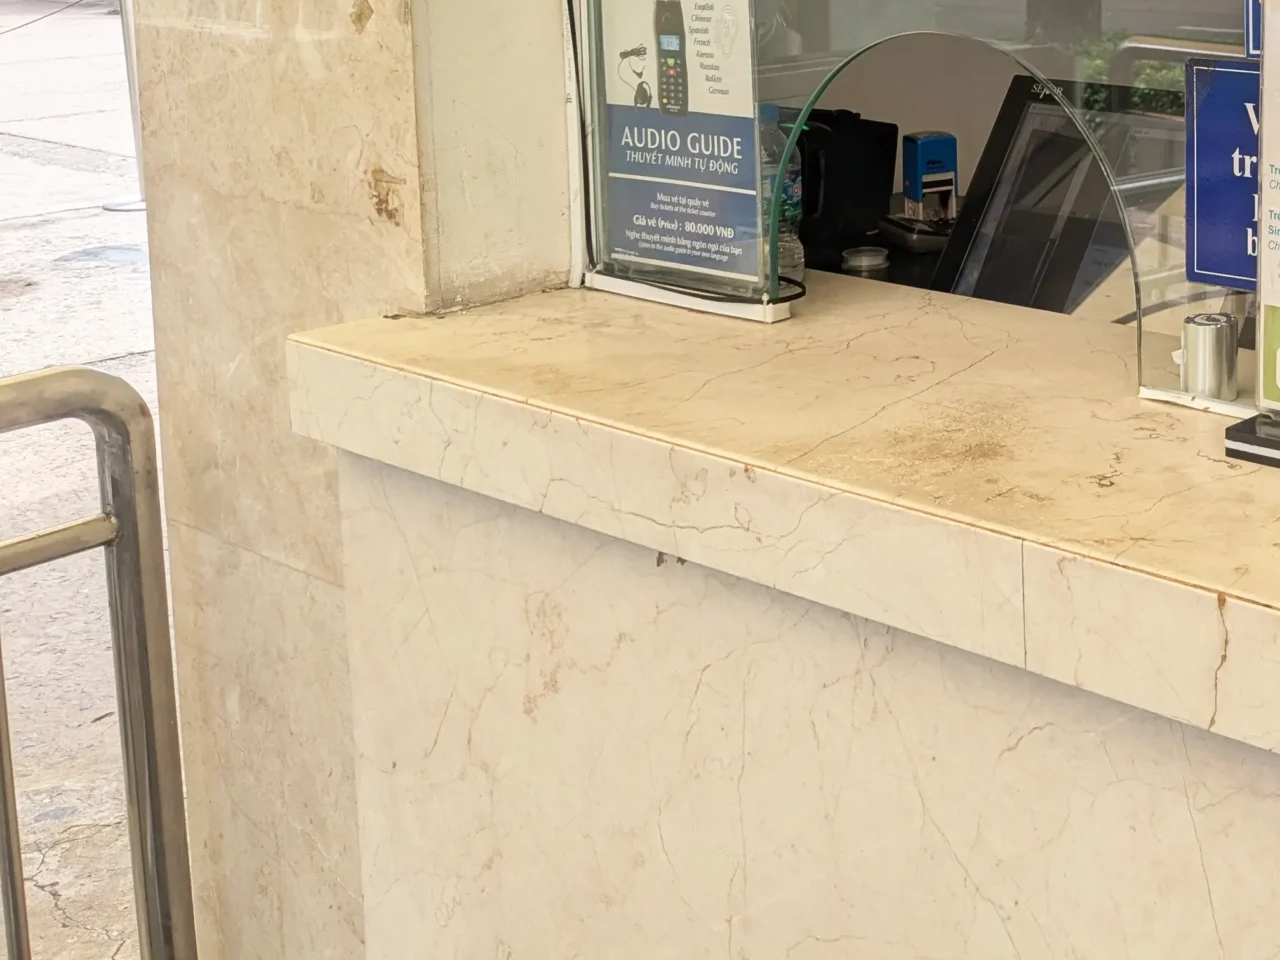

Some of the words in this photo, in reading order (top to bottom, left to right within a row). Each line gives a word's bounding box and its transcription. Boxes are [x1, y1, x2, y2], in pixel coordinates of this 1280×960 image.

[694, 2, 715, 13] English
[690, 14, 712, 23] Chinese
[688, 25, 710, 37] Spanish
[621, 125, 681, 151] AUDIO
[686, 132, 743, 159] GUIDE
[625, 150, 663, 165] THUYẾT
[665, 155, 692, 169] MINH
[694, 157, 707, 172] TỰ
[709, 159, 739, 175] ĐỘNG
[633, 214, 646, 226] Giá
[647, 217, 656, 227] vé
[658, 217, 678, 231] (Price)
[685, 221, 715, 236] 80.000
